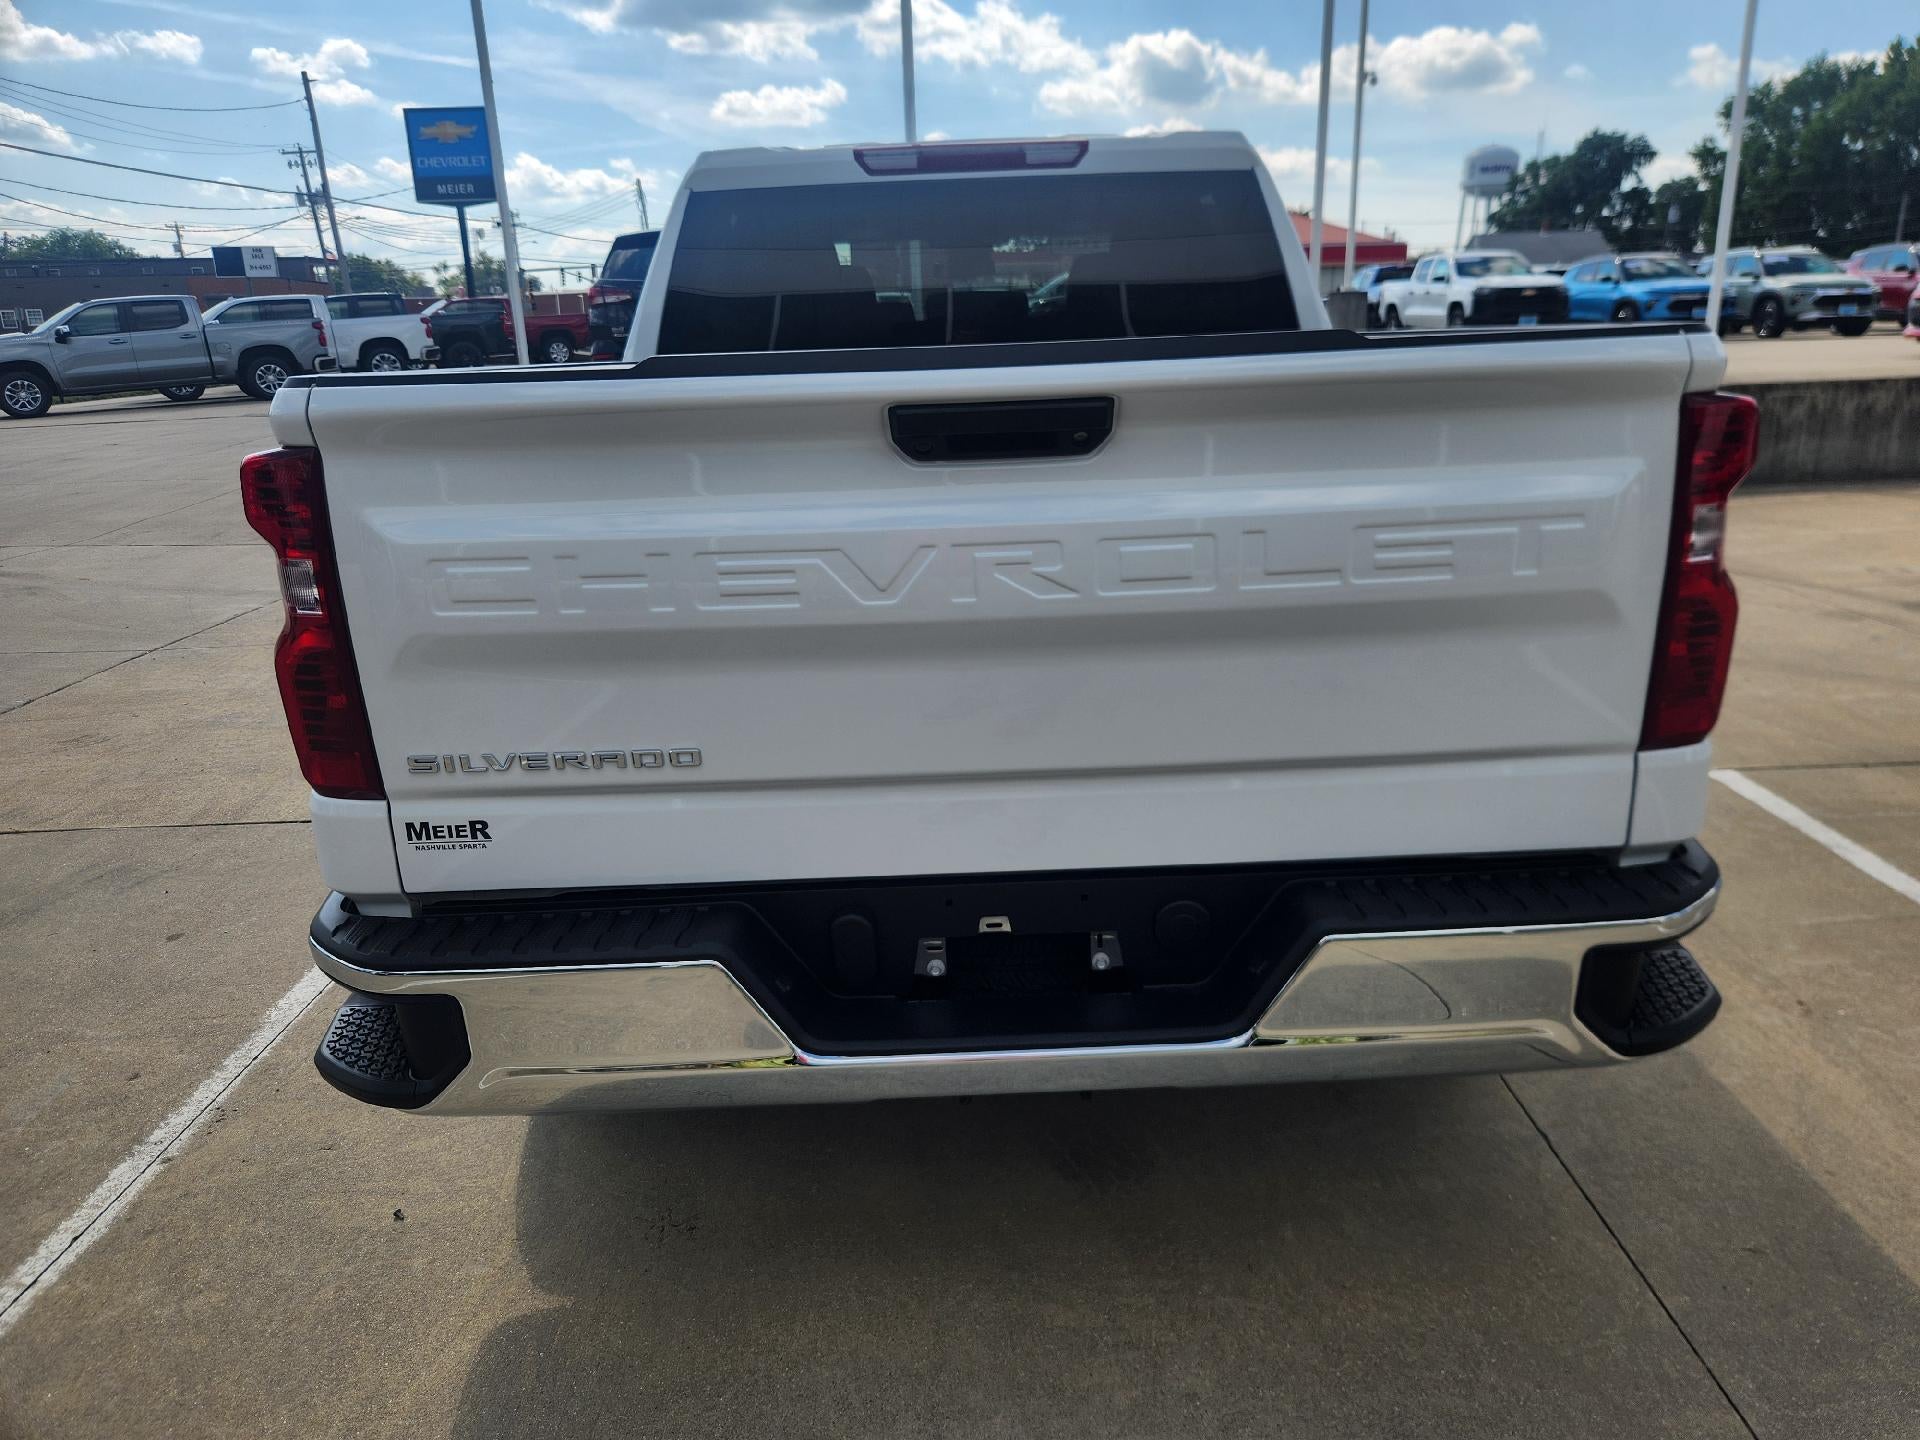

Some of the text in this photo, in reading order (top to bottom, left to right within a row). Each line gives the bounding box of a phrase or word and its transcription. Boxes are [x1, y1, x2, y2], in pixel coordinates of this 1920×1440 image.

[416, 156, 488, 169] CHEVROLET
[436, 183, 475, 195] MEIER
[428, 514, 1586, 617] CHEVROLET
[407, 748, 702, 773] SILVERADO
[405, 820, 492, 842] MEIER
